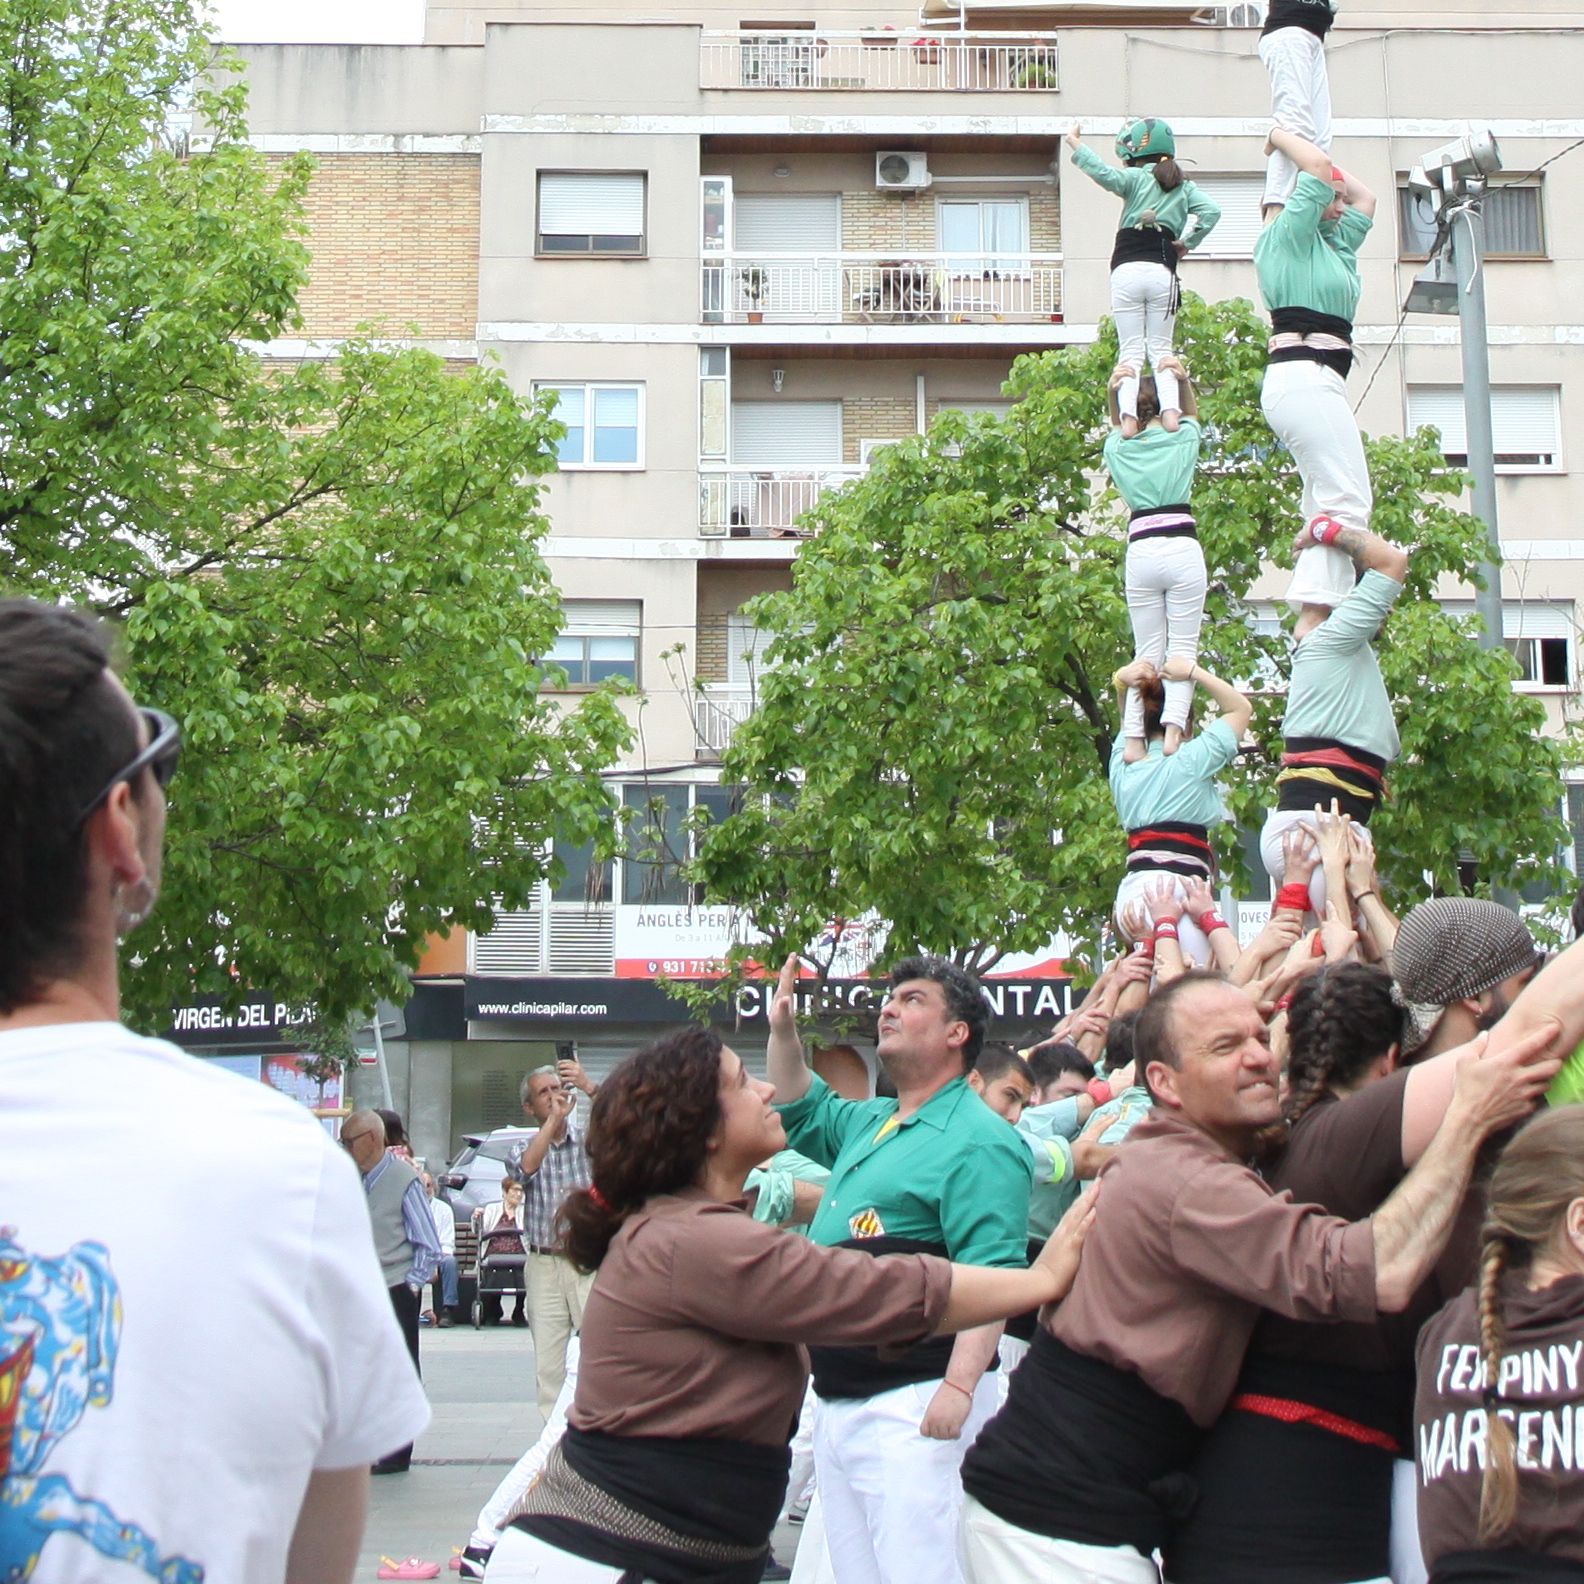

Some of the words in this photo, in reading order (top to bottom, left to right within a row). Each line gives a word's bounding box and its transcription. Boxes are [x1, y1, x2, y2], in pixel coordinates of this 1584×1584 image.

[637, 911, 692, 927] ANGLÈS
[699, 914, 726, 927] PER
[1240, 911, 1269, 924] OVES
[663, 960, 685, 973] 931
[237, 1004, 270, 1027] DEL
[478, 1001, 607, 1016] www.clinicapilar.com
